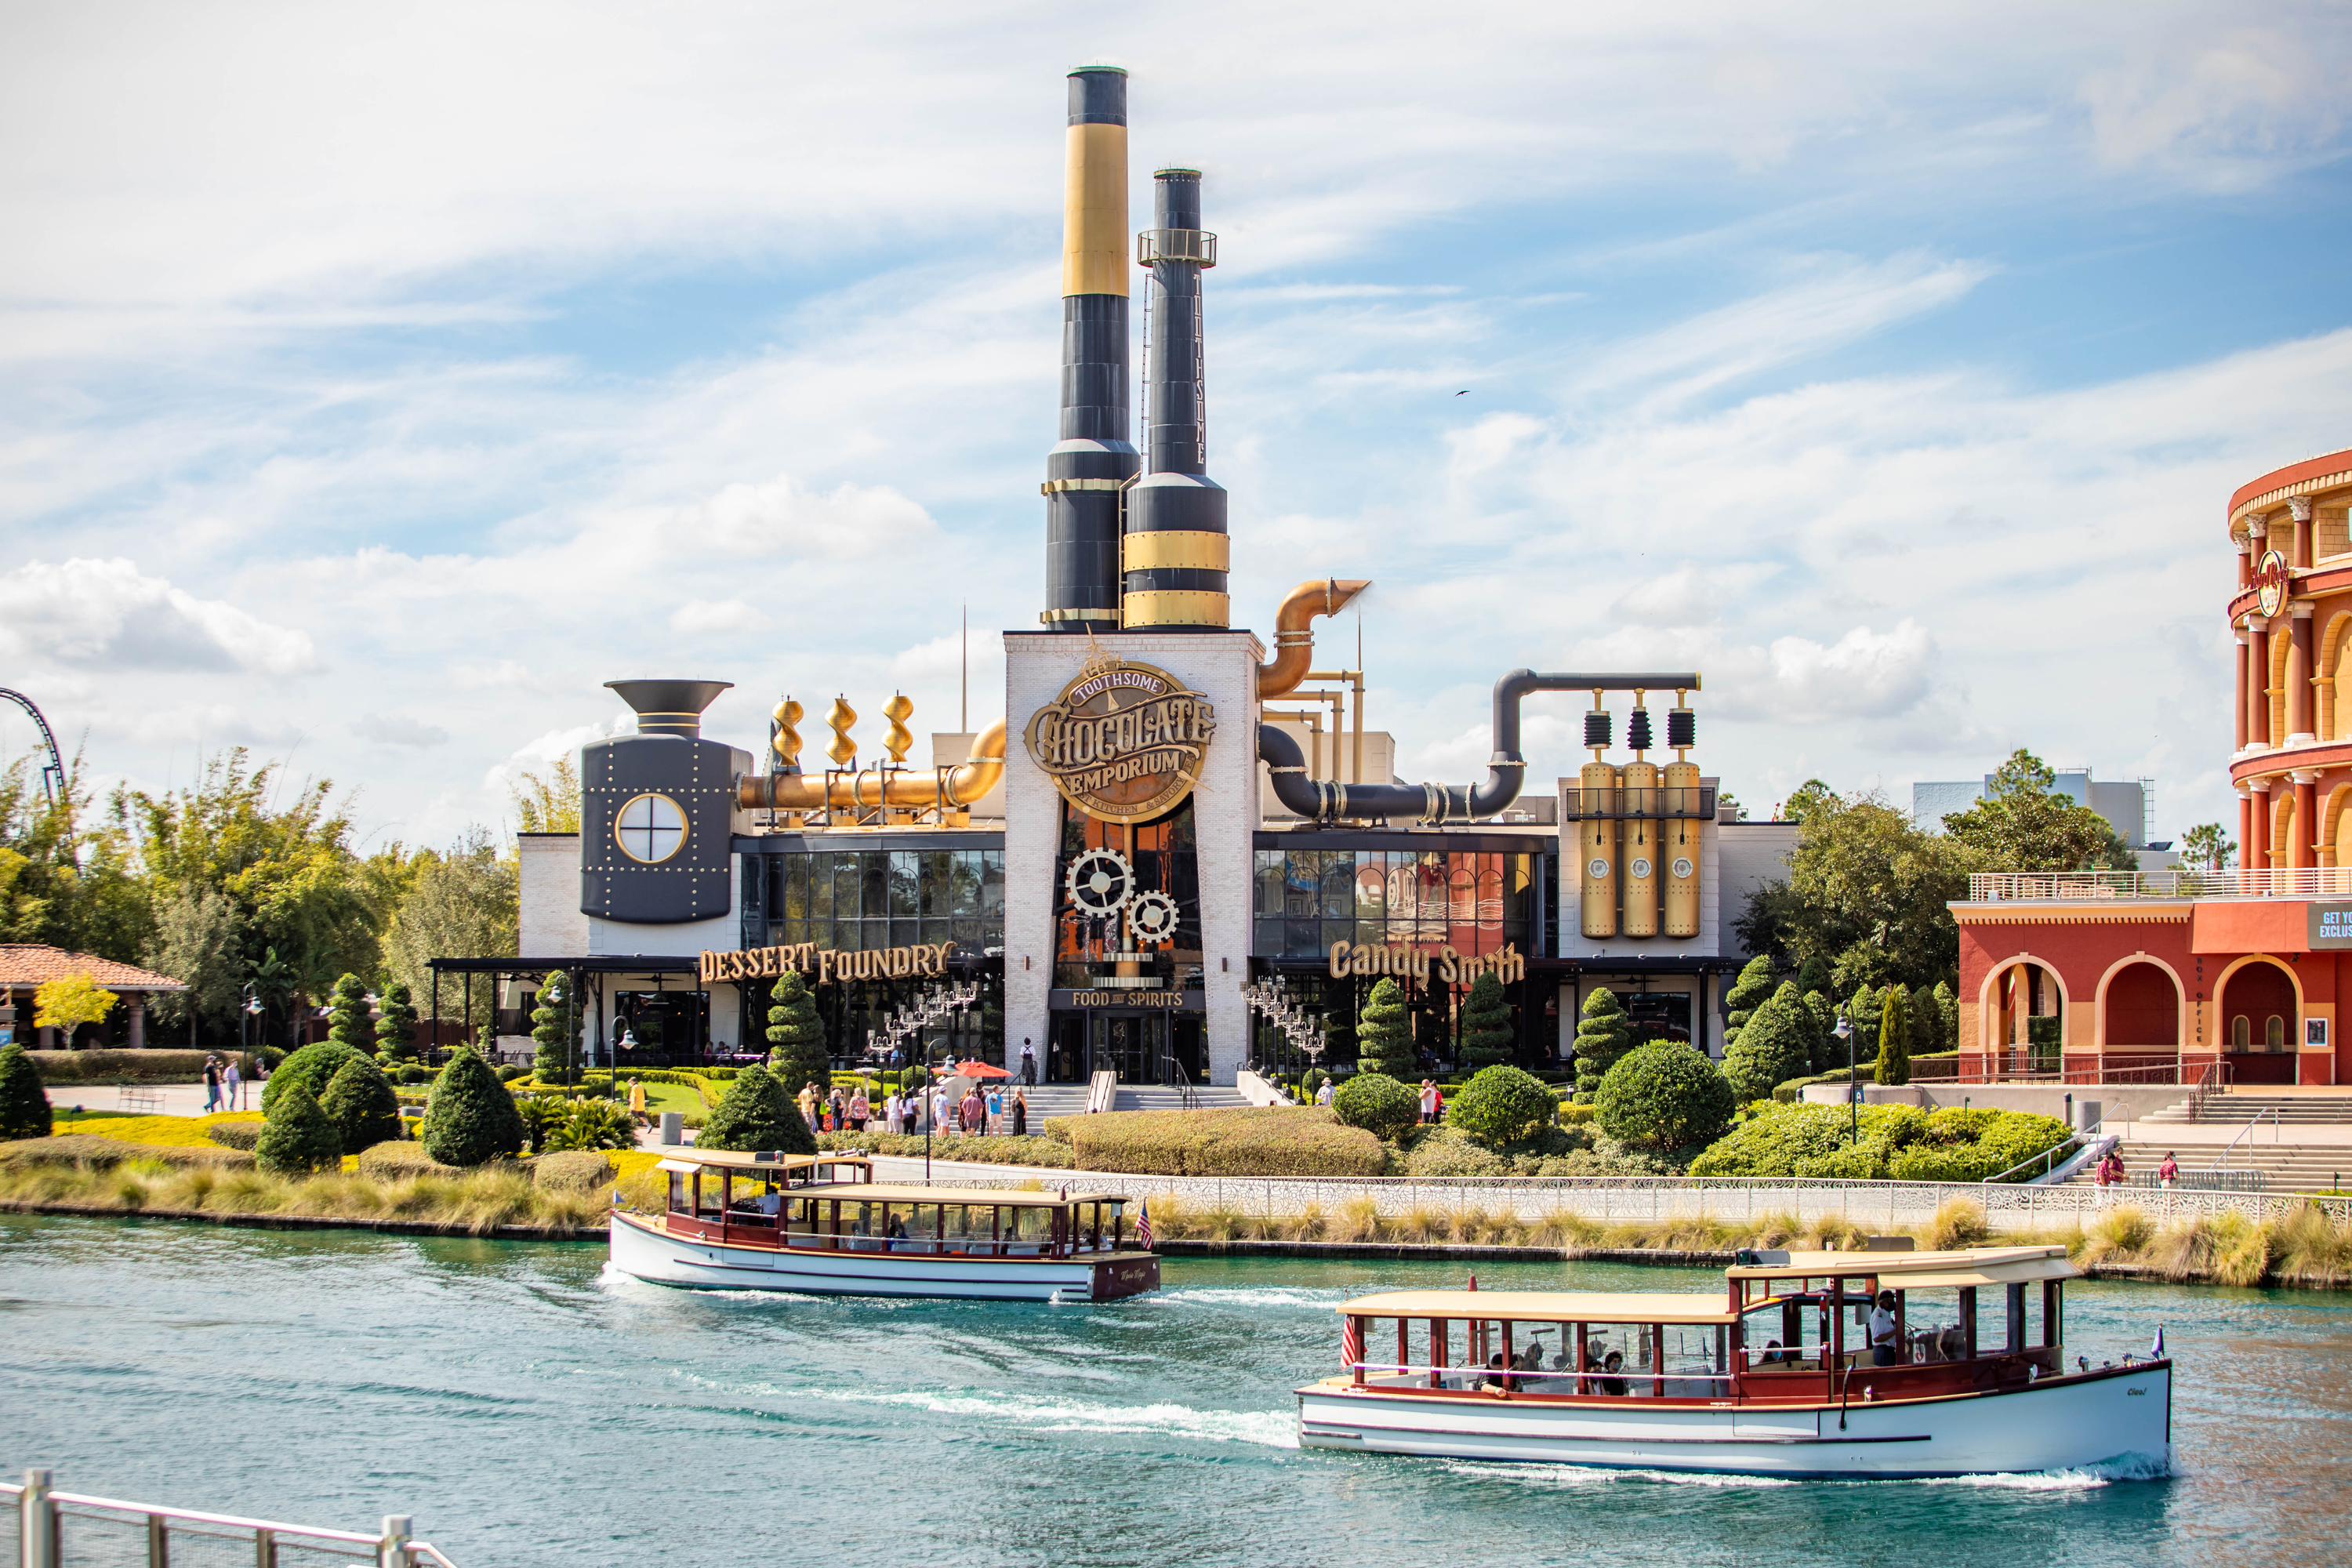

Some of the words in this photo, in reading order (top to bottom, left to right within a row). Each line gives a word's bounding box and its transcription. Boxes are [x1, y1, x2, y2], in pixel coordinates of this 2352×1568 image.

[1193, 274, 1204, 464] TOOTHSOME
[1075, 673, 1160, 700] TOOTHSOME
[1022, 699, 1217, 774] CHOCOLATE
[1069, 750, 1181, 796] EMPORIUM
[1092, 800, 1138, 814] KITCHEN
[1146, 801, 1154, 810] &
[1155, 776, 1184, 807] SAVORY
[2323, 912, 2340, 924] GET
[700, 942, 818, 983] DESSERT
[818, 941, 958, 985] FOUNDRY
[1330, 937, 1431, 991] Candy
[1073, 992, 1109, 1006] FOOD
[1128, 992, 1182, 1007] SPIRITS
